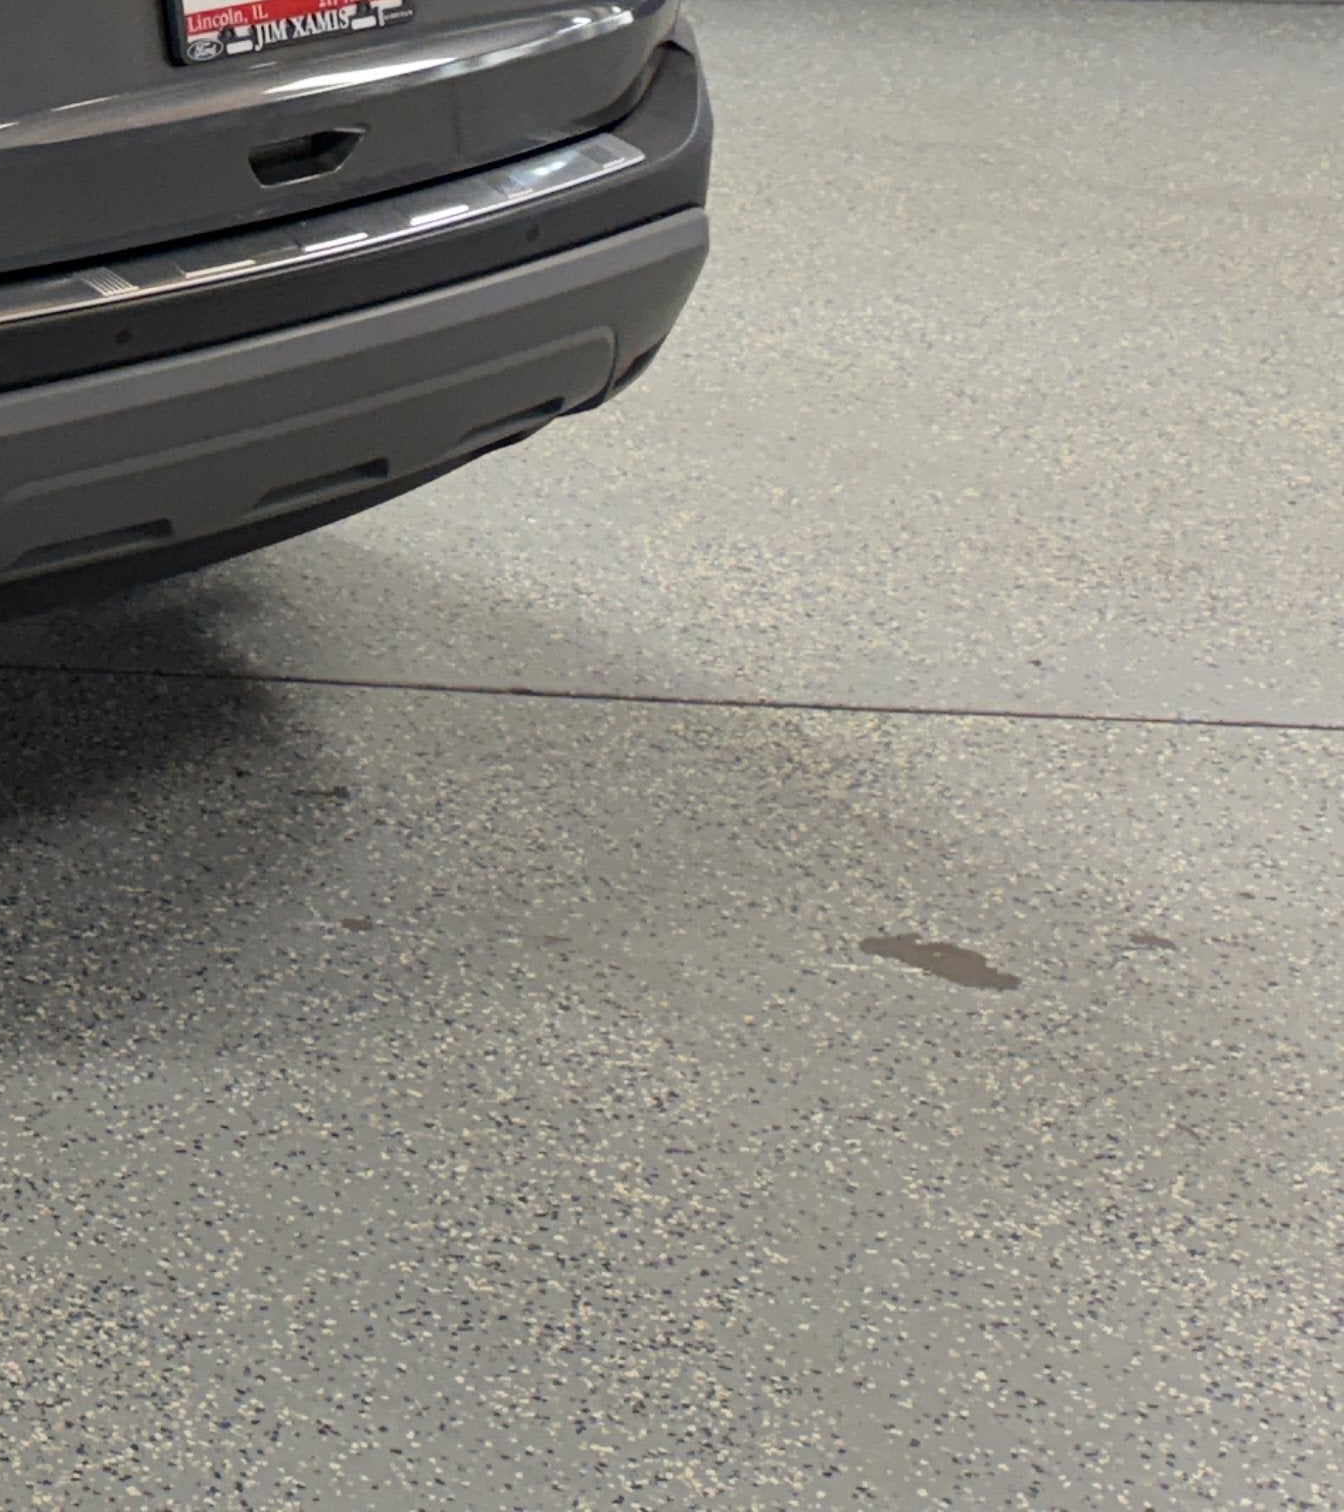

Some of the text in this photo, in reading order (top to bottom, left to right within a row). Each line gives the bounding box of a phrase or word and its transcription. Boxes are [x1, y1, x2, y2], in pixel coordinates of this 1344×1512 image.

[252, 5, 269, 20] IL
[255, 21, 289, 52] JIM
[293, 9, 351, 38] XAMIS
